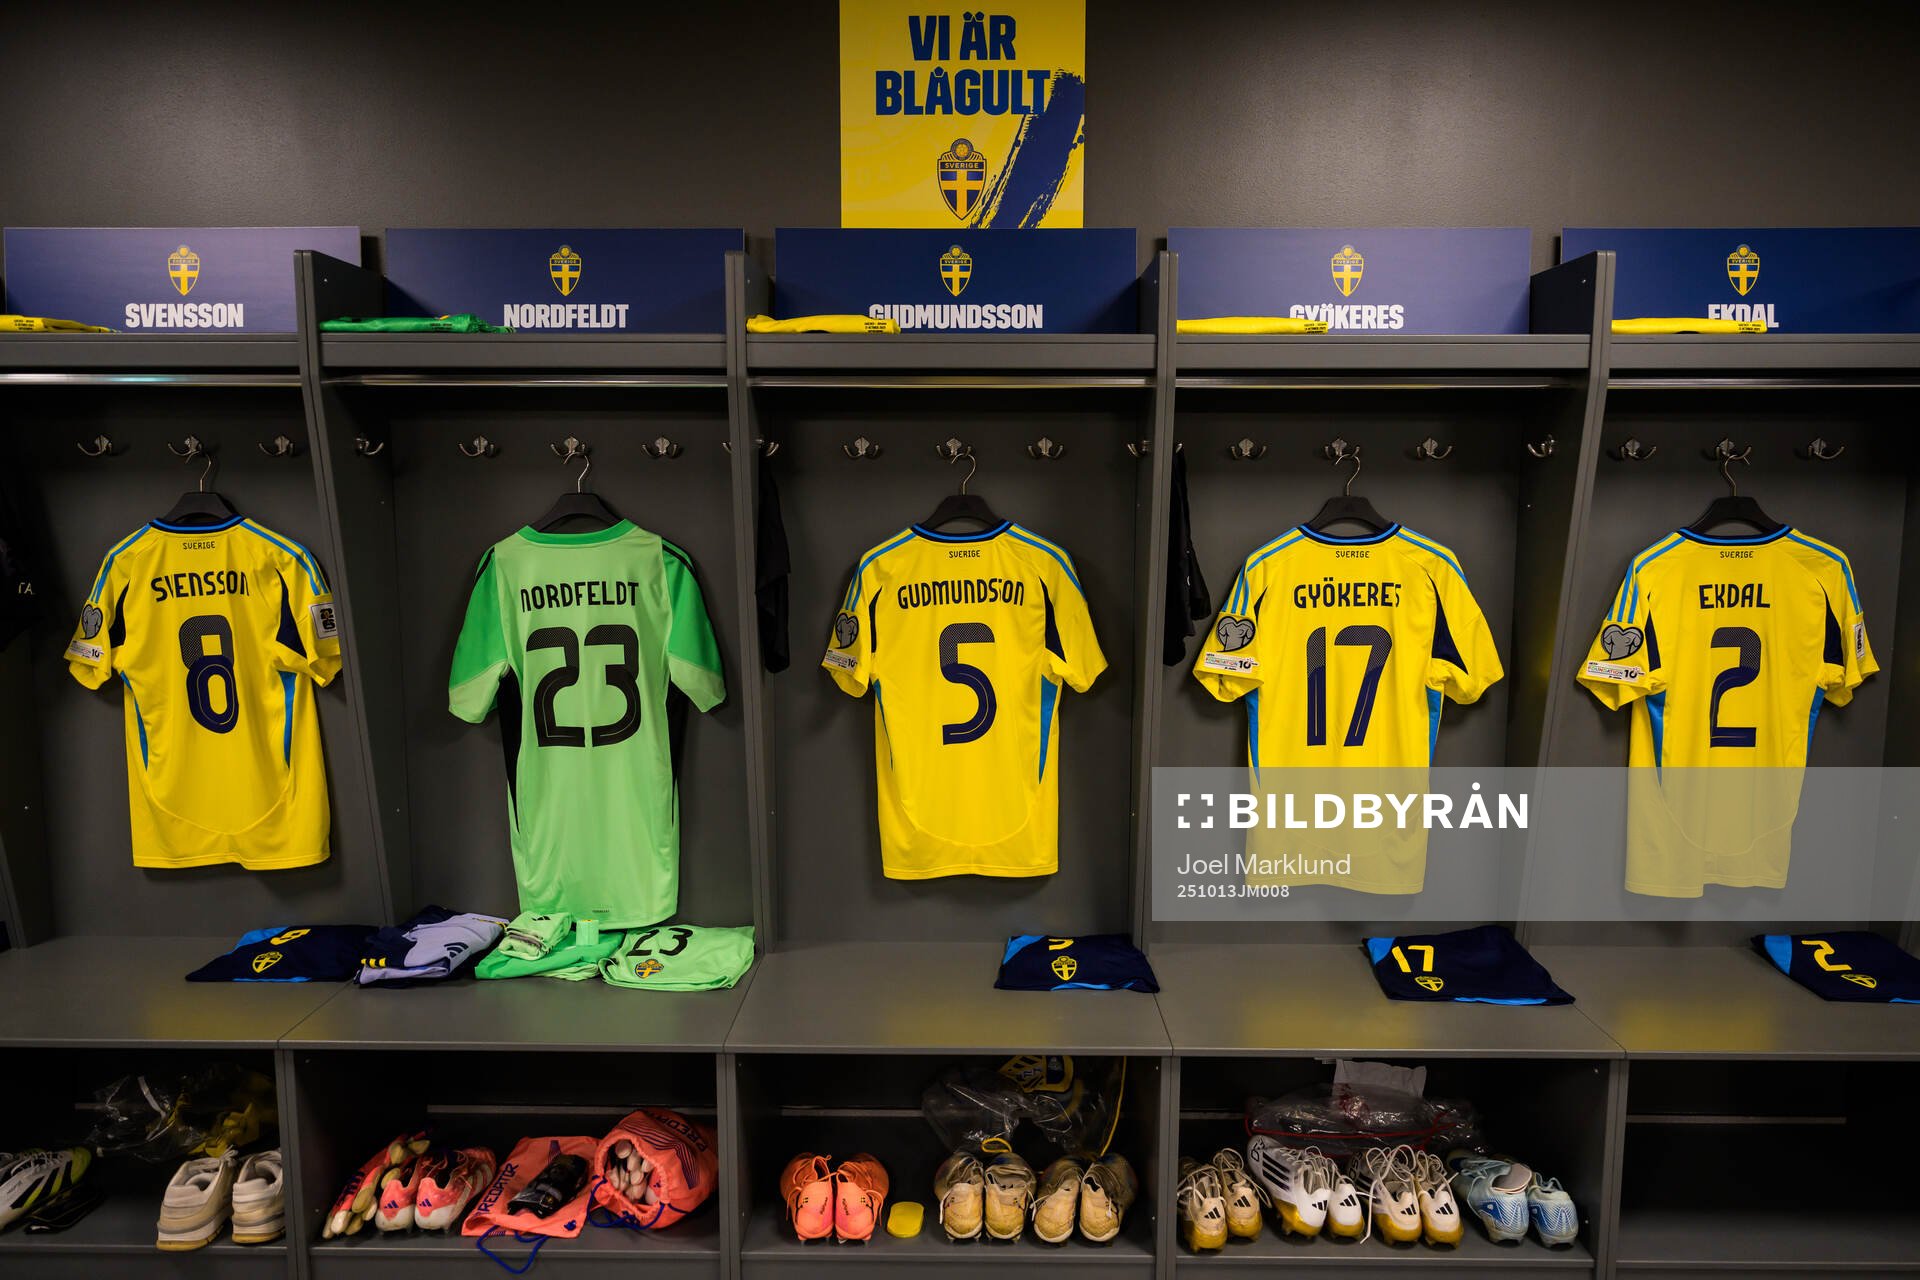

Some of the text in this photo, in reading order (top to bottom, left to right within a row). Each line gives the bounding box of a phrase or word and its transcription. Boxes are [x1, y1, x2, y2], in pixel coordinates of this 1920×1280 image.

[908, 11, 1017, 61] VI ÄR
[875, 66, 1051, 116] BLÅGULT
[125, 303, 244, 328] SVENSSON
[503, 304, 629, 329] NORDFELDT
[869, 304, 1043, 329] GUDMUNDSSON
[1708, 304, 1779, 328] EKDAL
[182, 541, 216, 550] SVERIGE
[948, 550, 981, 559] SVERIGE
[1335, 550, 1370, 559] SVERIGE
[1719, 550, 1754, 559] SVERIGE
[150, 570, 249, 602] SVENSSON
[520, 581, 640, 613] NORDFELDT
[1699, 583, 1771, 610] EKDAL
[178, 614, 240, 734] 8
[526, 624, 642, 748] 23
[938, 622, 997, 746] 5
[1306, 625, 1393, 747] 17
[1624, 669, 1638, 679] 10
[1709, 626, 1762, 748] 2
[1391, 944, 1435, 973] 17
[1801, 940, 1852, 972] 2
